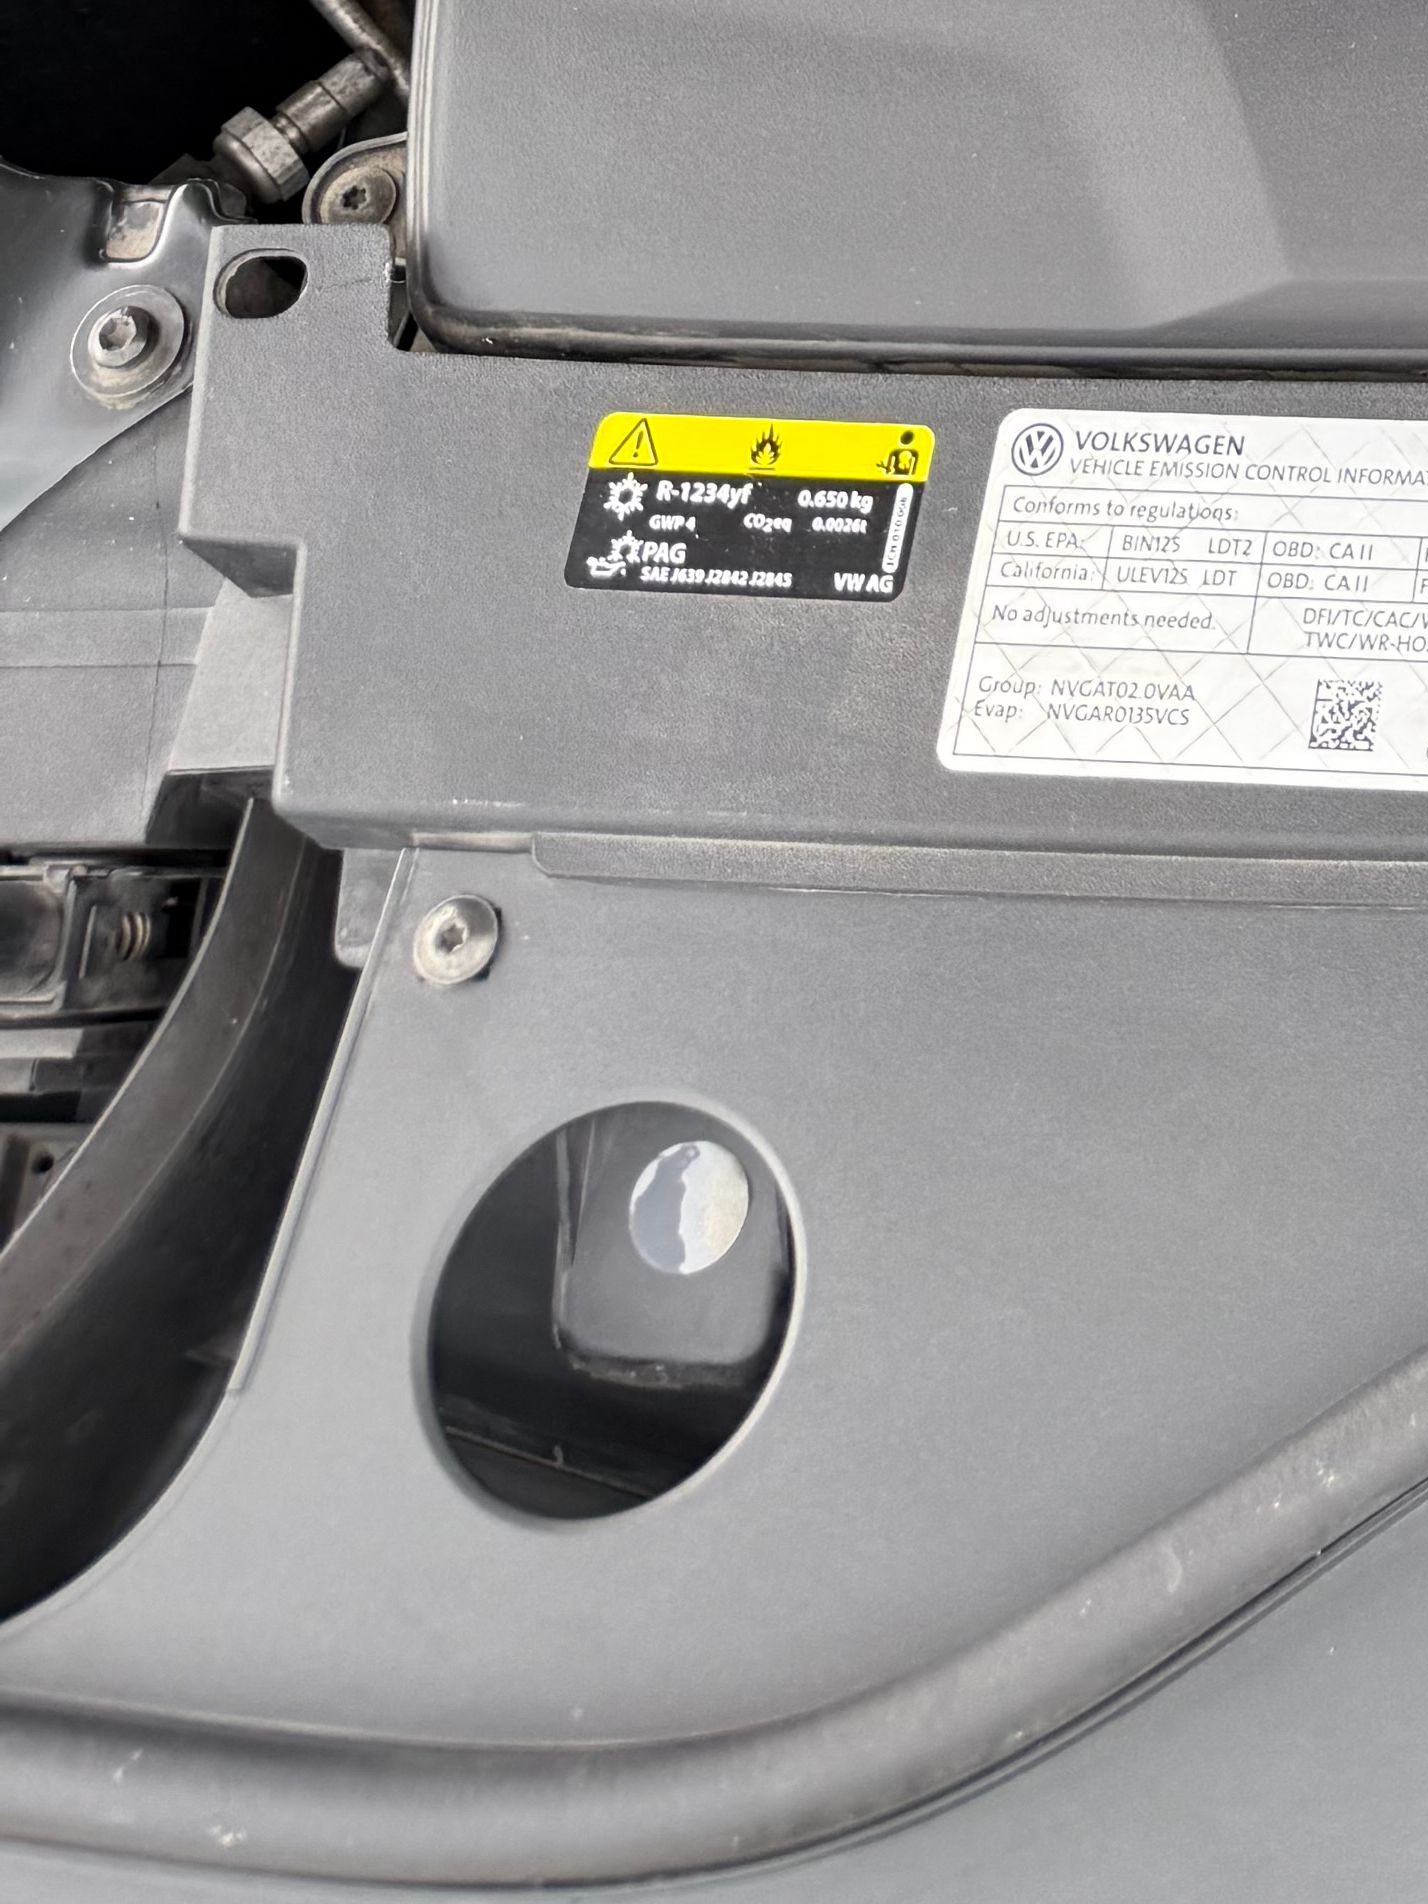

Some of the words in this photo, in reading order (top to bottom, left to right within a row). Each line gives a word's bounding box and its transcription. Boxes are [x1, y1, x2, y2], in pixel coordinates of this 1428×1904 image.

[1076, 431, 1244, 455] VOLKSWAGEN
[1070, 458, 1144, 476] VEHICLE
[1150, 460, 1239, 479] EMISSION
[1245, 464, 1331, 483] CONTROL
[656, 480, 754, 509] R-1234yf
[798, 490, 849, 508] 0.650
[850, 491, 874, 514] kg
[1013, 496, 1100, 516] Conforms
[1107, 500, 1124, 516] to
[1130, 502, 1238, 522] regulations:
[1007, 531, 1039, 548] U.S.
[1122, 535, 1180, 552] BIN125
[1208, 538, 1252, 556] LDT2
[642, 542, 687, 564] PAG
[1330, 543, 1354, 559] CA
[640, 567, 669, 583] SAE
[1000, 561, 1095, 580] California:
[1118, 565, 1188, 584] ULEV125
[1202, 570, 1237, 586] LDT
[834, 572, 866, 592] VW
[868, 575, 894, 594] AG
[1324, 574, 1351, 592] CA
[992, 604, 1017, 621] No
[1022, 605, 1139, 628] adjustments
[1144, 612, 1216, 630] needed.
[979, 676, 1042, 698] Group:
[974, 700, 1023, 723] Evap:
